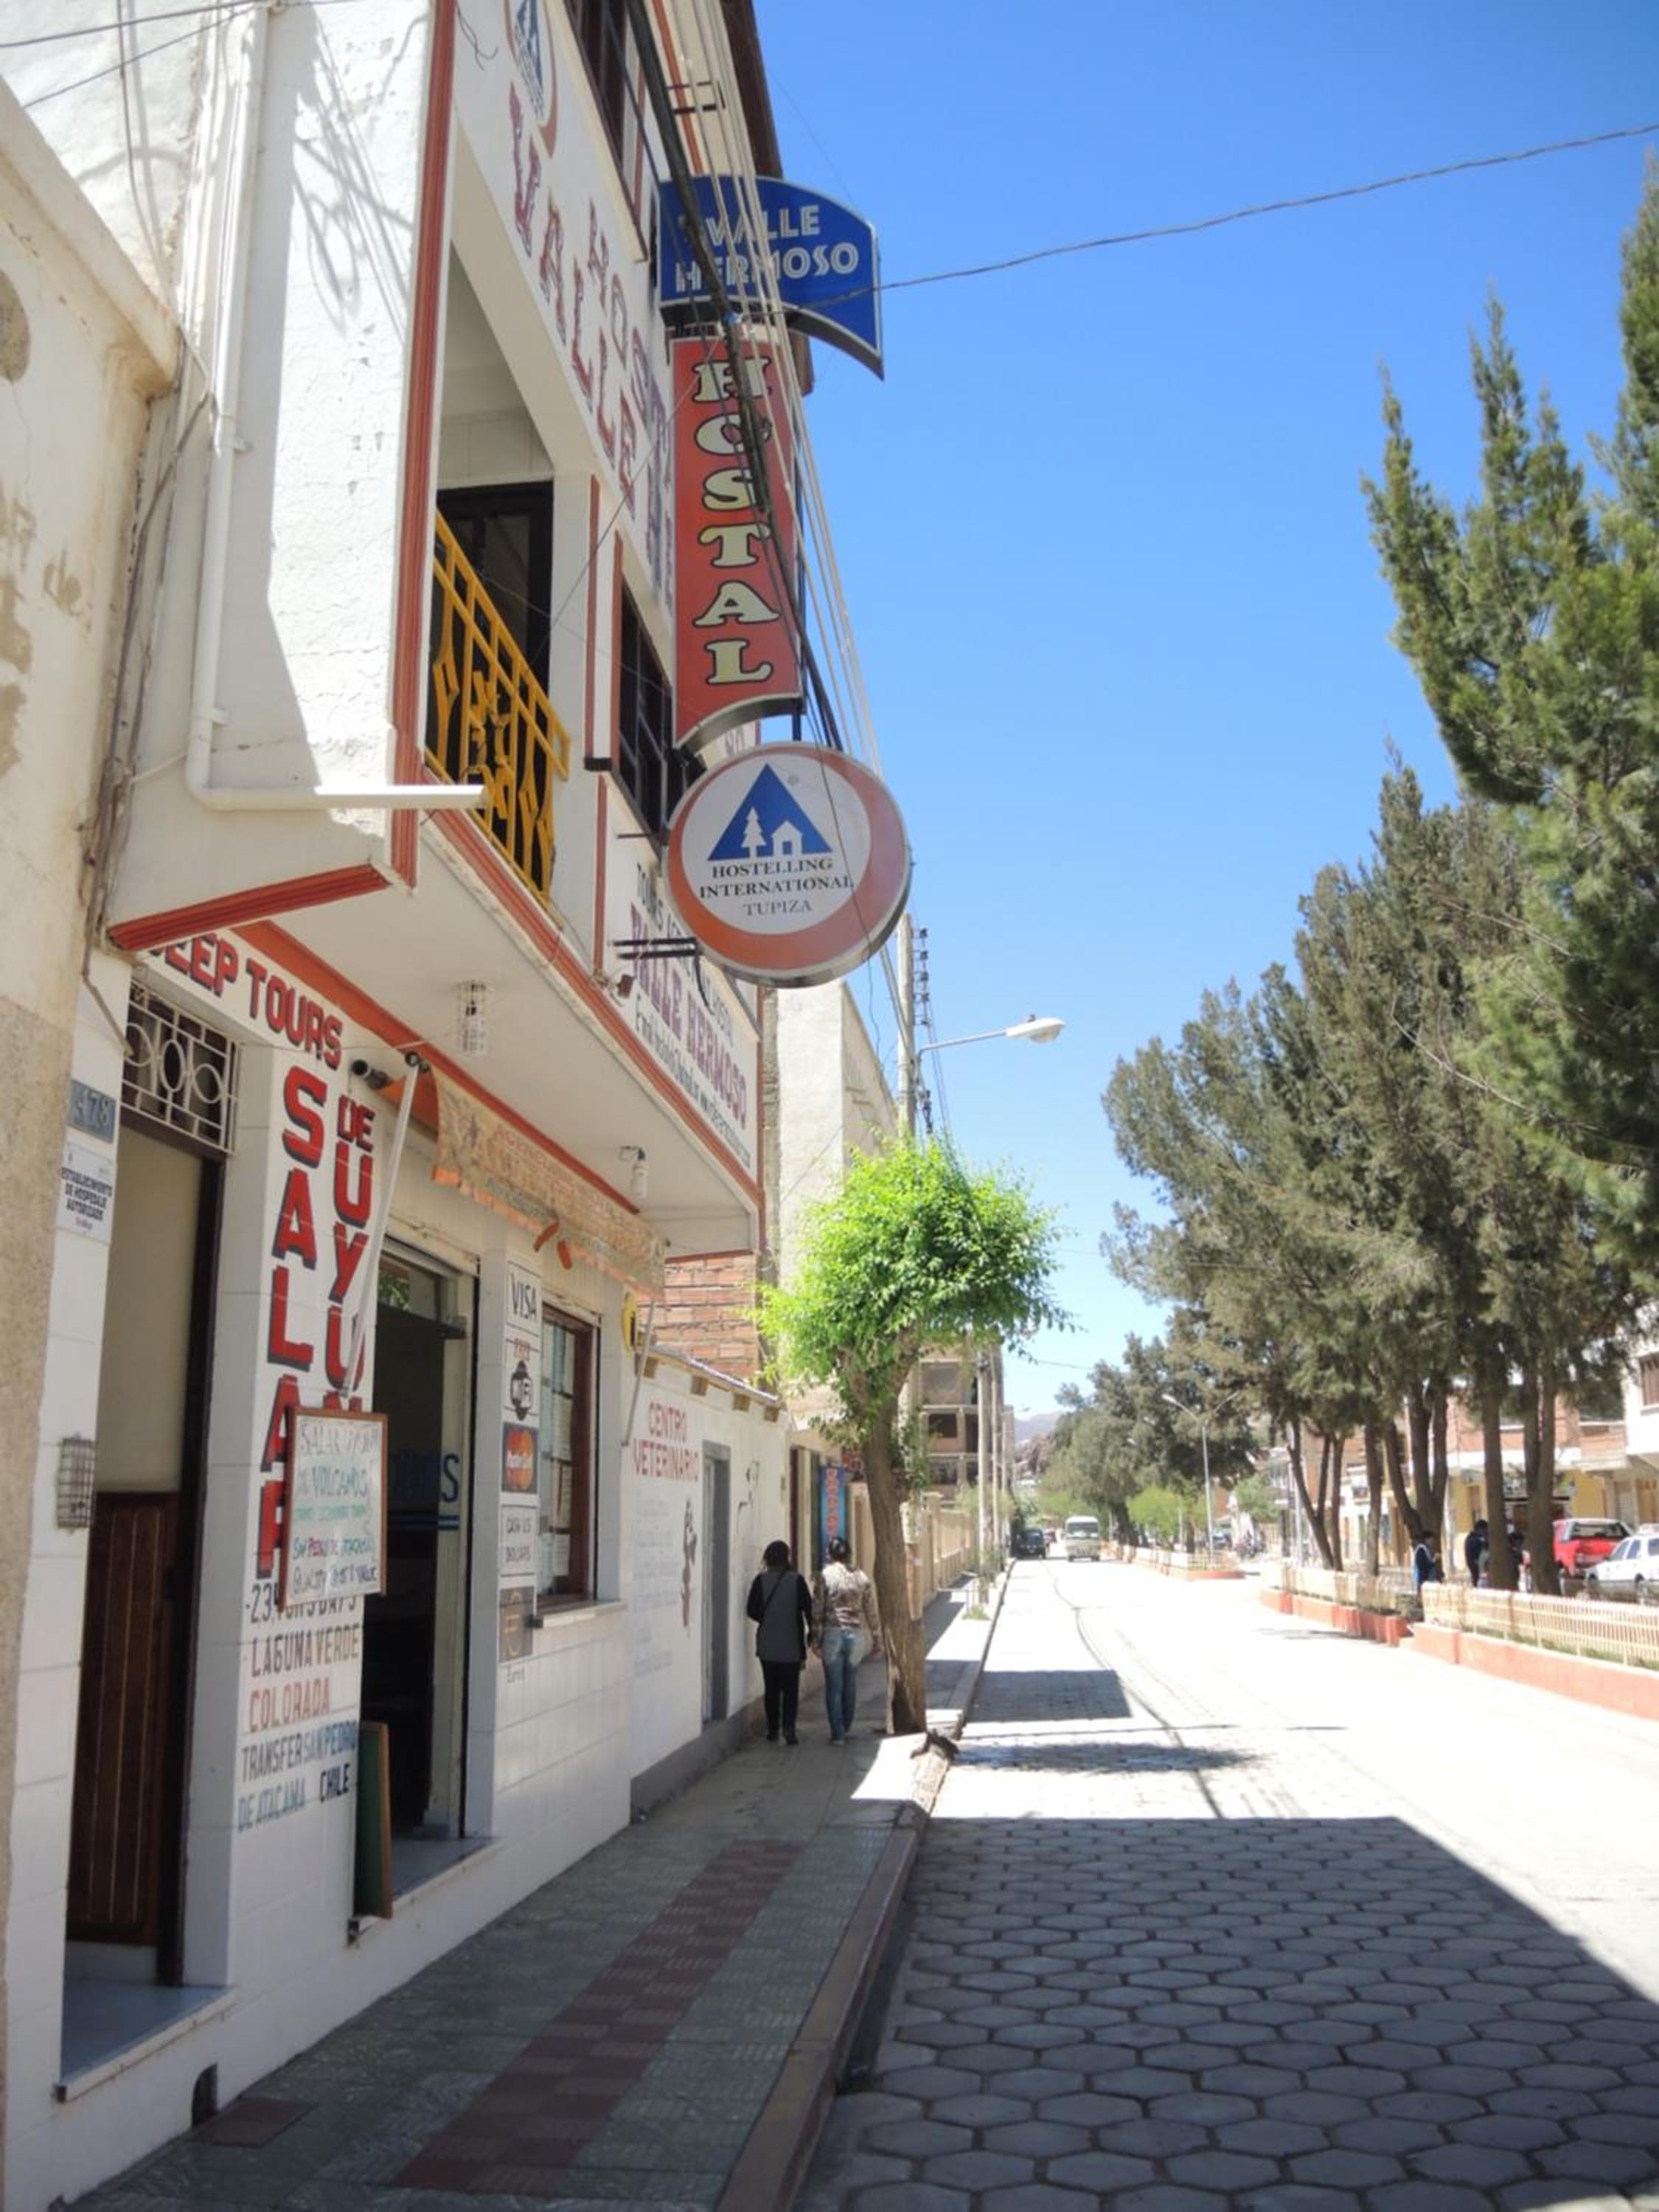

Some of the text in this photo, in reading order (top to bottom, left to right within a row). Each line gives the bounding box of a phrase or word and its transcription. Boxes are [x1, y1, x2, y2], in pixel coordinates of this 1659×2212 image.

[509, 81, 636, 522] VALLE
[691, 356, 781, 686] HOSTAL
[700, 875, 854, 899] INTERNATIONAL
[712, 858, 833, 879] HOSTELLING
[742, 899, 813, 917] TUPIZA
[149, 931, 344, 1071] EEP TOURS
[336, 1094, 376, 1152] DE
[323, 1140, 375, 1411] UYU
[510, 1273, 538, 1321] VISA
[648, 1401, 686, 1443] CENTRO
[632, 1439, 699, 1482] VETERINARIO
[251, 1624, 360, 1678] LAGUNA VERDE
[248, 1677, 331, 1733] COLORADA
[242, 1733, 303, 1783] TRANSFER
[319, 1761, 350, 1804] CHILE
